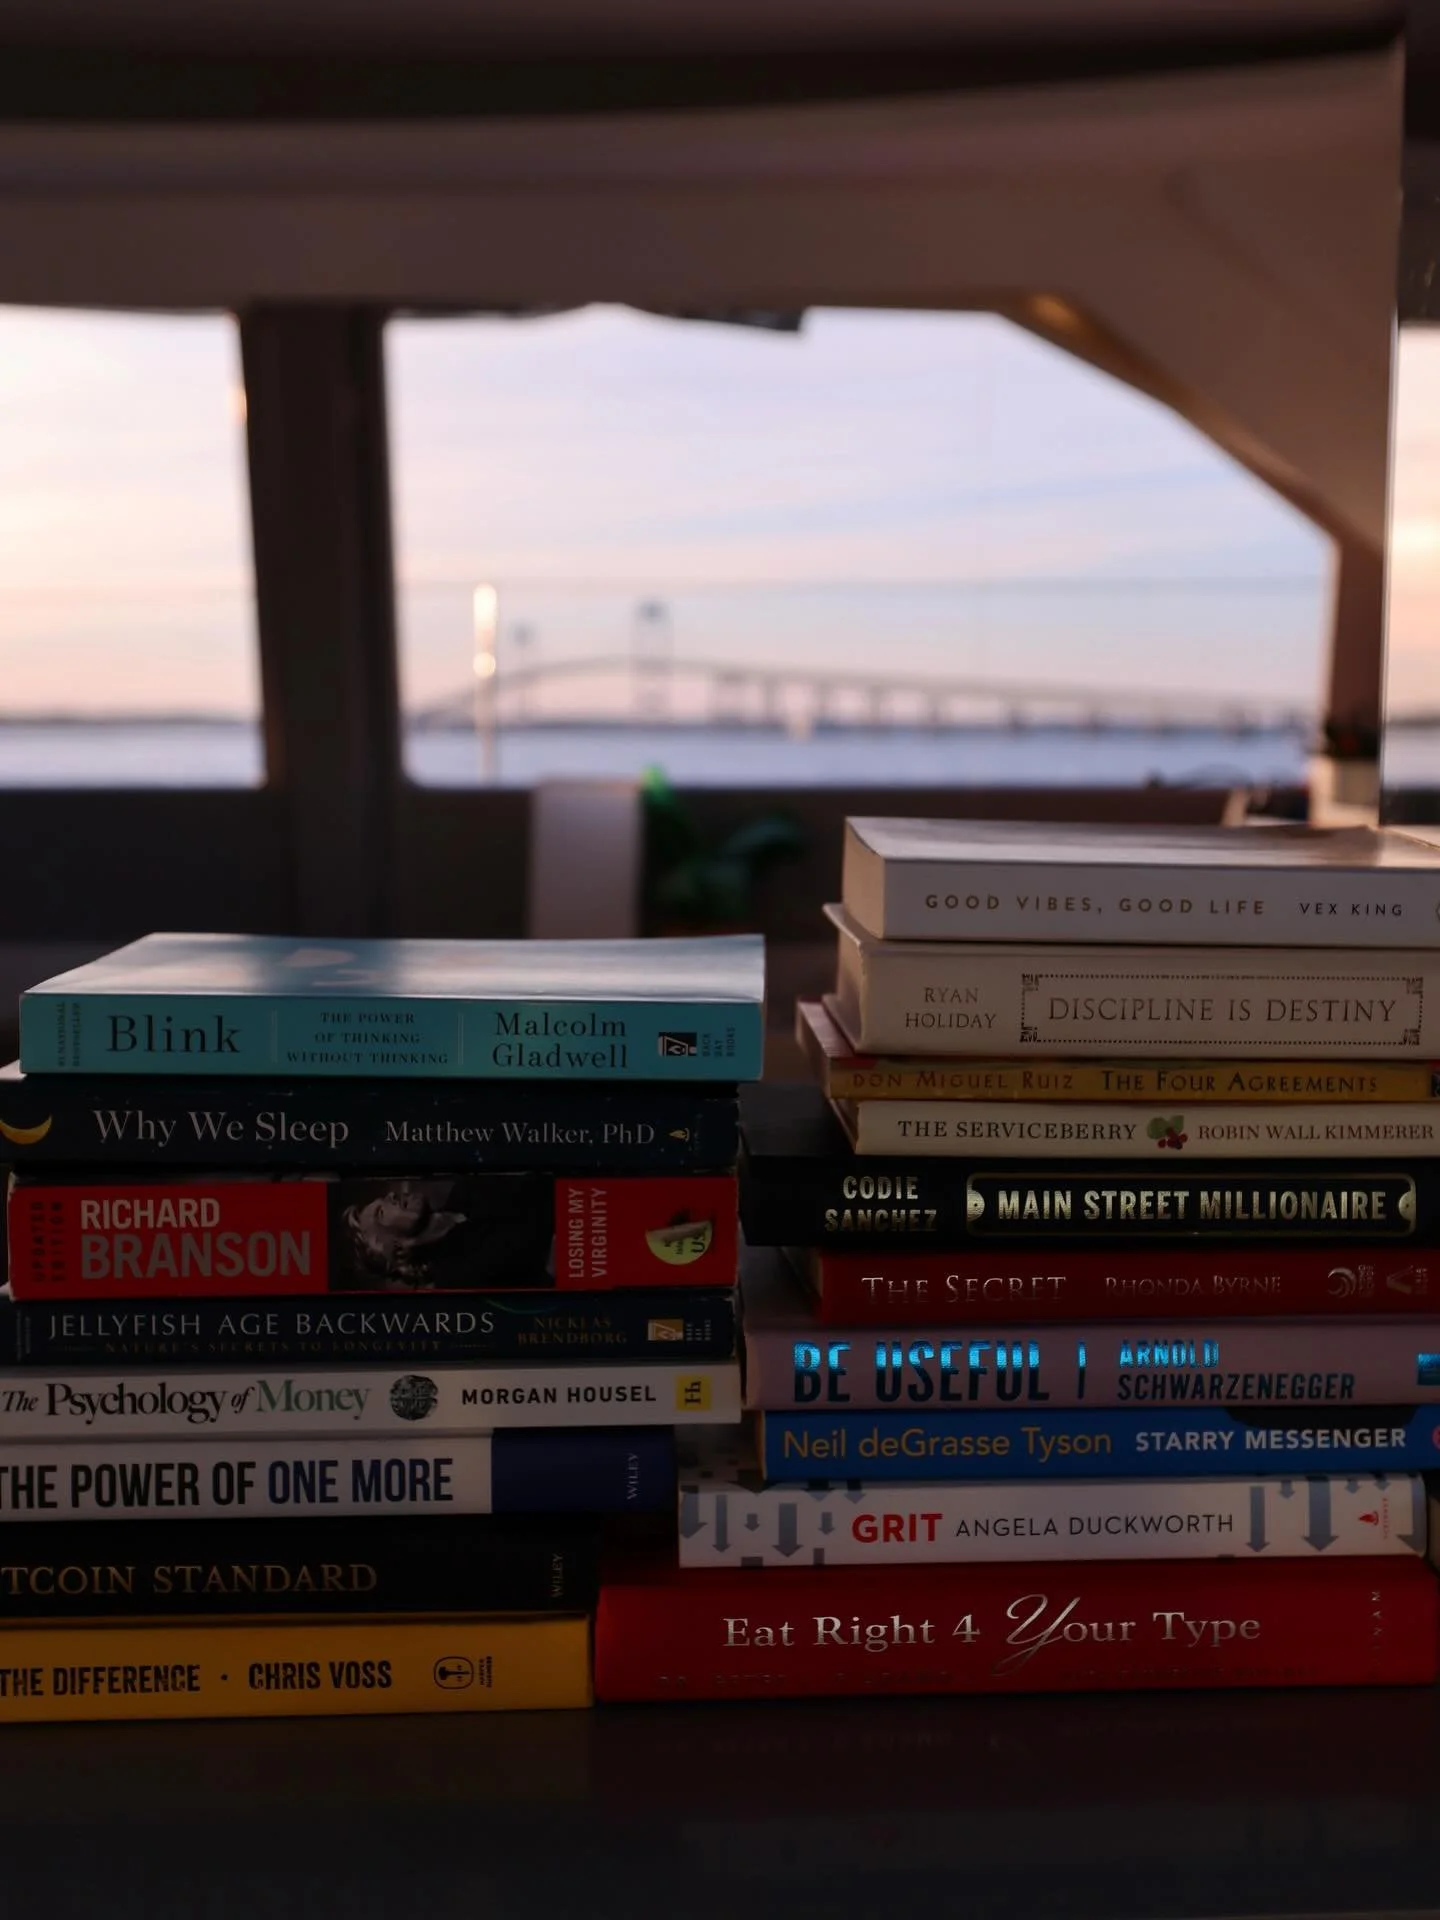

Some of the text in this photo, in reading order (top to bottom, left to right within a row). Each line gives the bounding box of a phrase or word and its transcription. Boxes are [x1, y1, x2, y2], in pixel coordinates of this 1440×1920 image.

[925, 894, 1264, 914] GOOD VIBES, GOOD LIFE
[1300, 903, 1402, 916] VEX KING
[924, 987, 979, 1003] RYAN
[320, 1013, 414, 1024] THE POWER
[905, 1012, 996, 1029] HOLIDAY
[1049, 997, 1396, 1022] DISCIPLINE IS DESTINY
[106, 1014, 242, 1053] Blink
[495, 1012, 627, 1037] Malcolm
[315, 1032, 420, 1044] OF THINKING
[702, 1033, 711, 1057] BACK
[726, 1026, 735, 1057] BOOKS
[286, 1052, 448, 1065] WITHOUT THINKING
[492, 1043, 628, 1069] Gladwell
[1023, 1071, 1073, 1089] RUIZ
[1101, 1070, 1377, 1092] THE FOUR AGREEMENTS
[93, 1109, 349, 1149] Why We Sleep
[384, 1121, 655, 1147] Matthew Walker, PhD
[898, 1120, 1137, 1140] THE SERVICEBERRY
[1199, 1124, 1433, 1140] ROBIN WALL KIMMERER
[842, 1175, 920, 1201] CODIE
[80, 1199, 220, 1230] RICHARD
[998, 1190, 1387, 1221] MAIN STREET MILLIONAIRE
[568, 1187, 585, 1279] LOSING MY
[592, 1187, 608, 1278] VIRGINITY
[824, 1208, 938, 1233] SANCHEZ
[80, 1230, 311, 1280] BRANSON
[861, 1274, 1066, 1304] THE SECRET
[1105, 1275, 1281, 1297] RHONDA BYRNE
[50, 1313, 200, 1340] JELLYFISH
[218, 1312, 279, 1336] AGE
[295, 1311, 495, 1335] BACKWARDS
[533, 1316, 613, 1329] NICKLAS
[208, 1341, 288, 1352] SECRETS
[300, 1341, 321, 1352] TO
[333, 1340, 440, 1352] LONGEVITY
[517, 1331, 628, 1345] BRENDBORG
[1119, 1339, 1219, 1369] ARNOLD
[793, 1339, 1049, 1403] BE USEFUL
[462, 1385, 656, 1405] MORGAN HOUSEL
[1117, 1373, 1354, 1401] SCHWARZENEGGER
[2, 1379, 371, 1425] The Psychology of Money
[784, 1425, 1111, 1463] Neil deGrasse Tyson
[1135, 1428, 1406, 1452] STARRY MESSENGER
[71, 1462, 200, 1508] POWER
[212, 1461, 256, 1505] OF
[269, 1460, 339, 1504] ONE
[352, 1458, 453, 1503] MORE
[626, 1453, 640, 1500] WILEY
[852, 1513, 943, 1543] GRIT
[956, 1514, 1233, 1538] ANGELA DUCKWORTH
[0, 1562, 378, 1596] TCOIN STANDARD
[550, 1552, 564, 1599] WILEY
[722, 1617, 795, 1648] Eat
[812, 1613, 935, 1653] Right
[951, 1613, 981, 1644] 4
[990, 1593, 1136, 1677] Your
[1153, 1610, 1261, 1648] Type
[0, 1664, 200, 1697] THE DIFFERENCE
[248, 1660, 392, 1691] CHRIS VOSS
